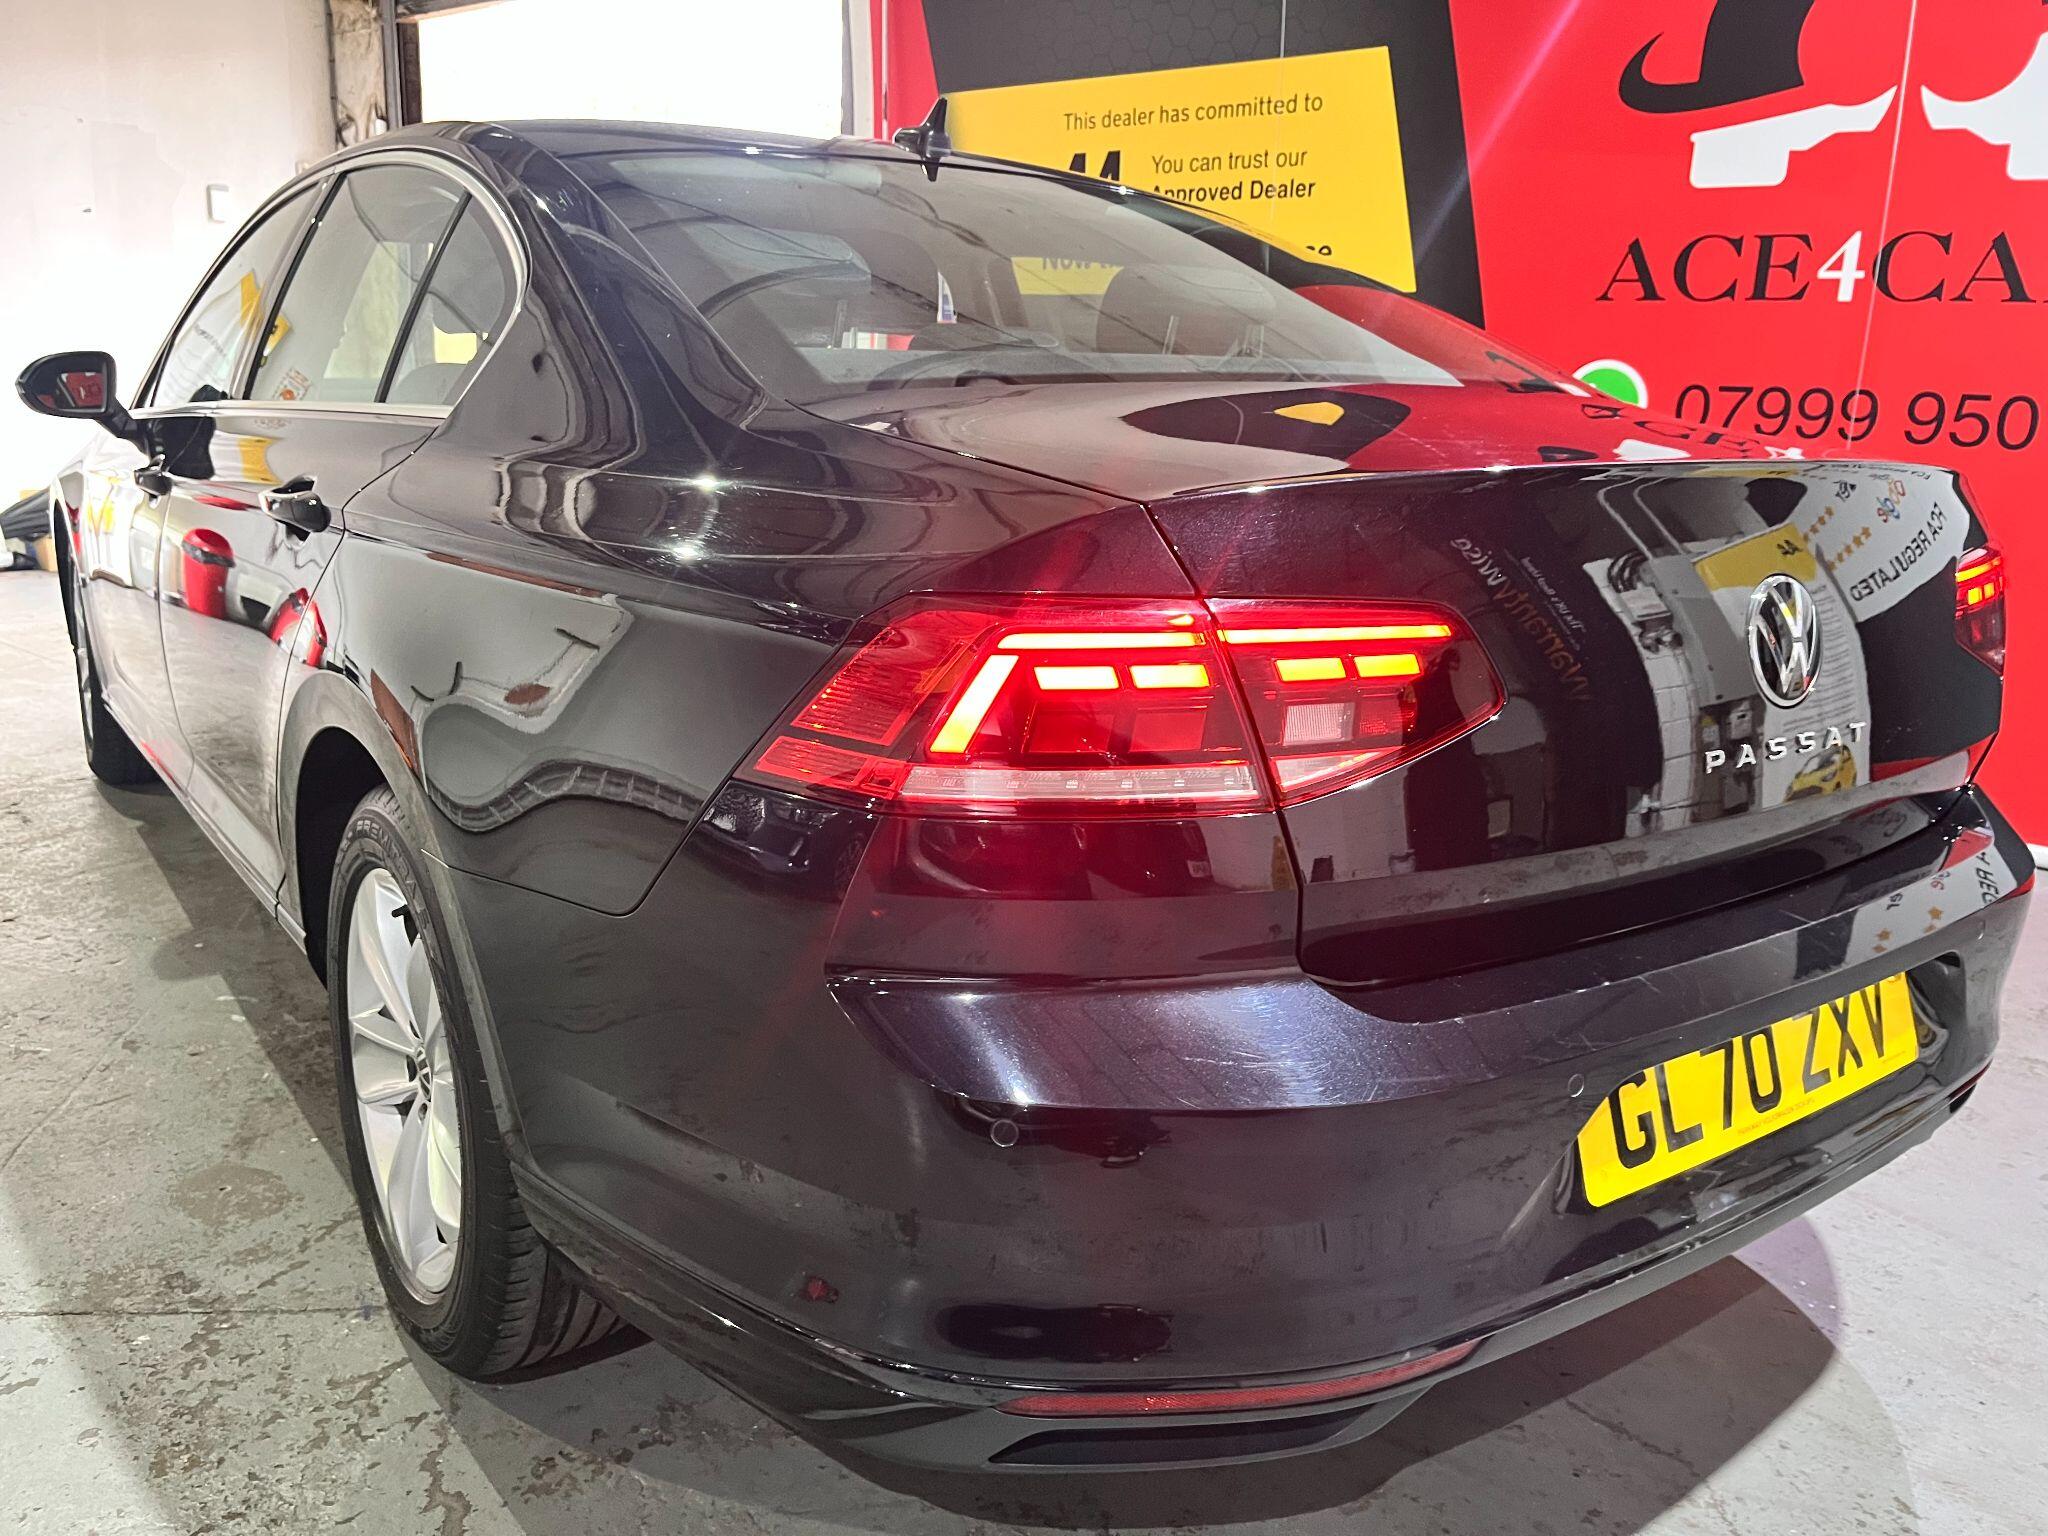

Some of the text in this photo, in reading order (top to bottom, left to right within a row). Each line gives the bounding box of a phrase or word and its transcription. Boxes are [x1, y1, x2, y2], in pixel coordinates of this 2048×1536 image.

[1063, 92, 1323, 131] This dealer has committed to
[1151, 149, 1309, 174] You can trust our
[1250, 178, 1316, 200] Dealer
[1595, 230, 2048, 304] ACE4CA
[1675, 383, 1880, 442] 07999
[1903, 390, 2040, 451] 950
[1705, 721, 1867, 774] PASSAT
[1791, 979, 1886, 1095] ZXV
